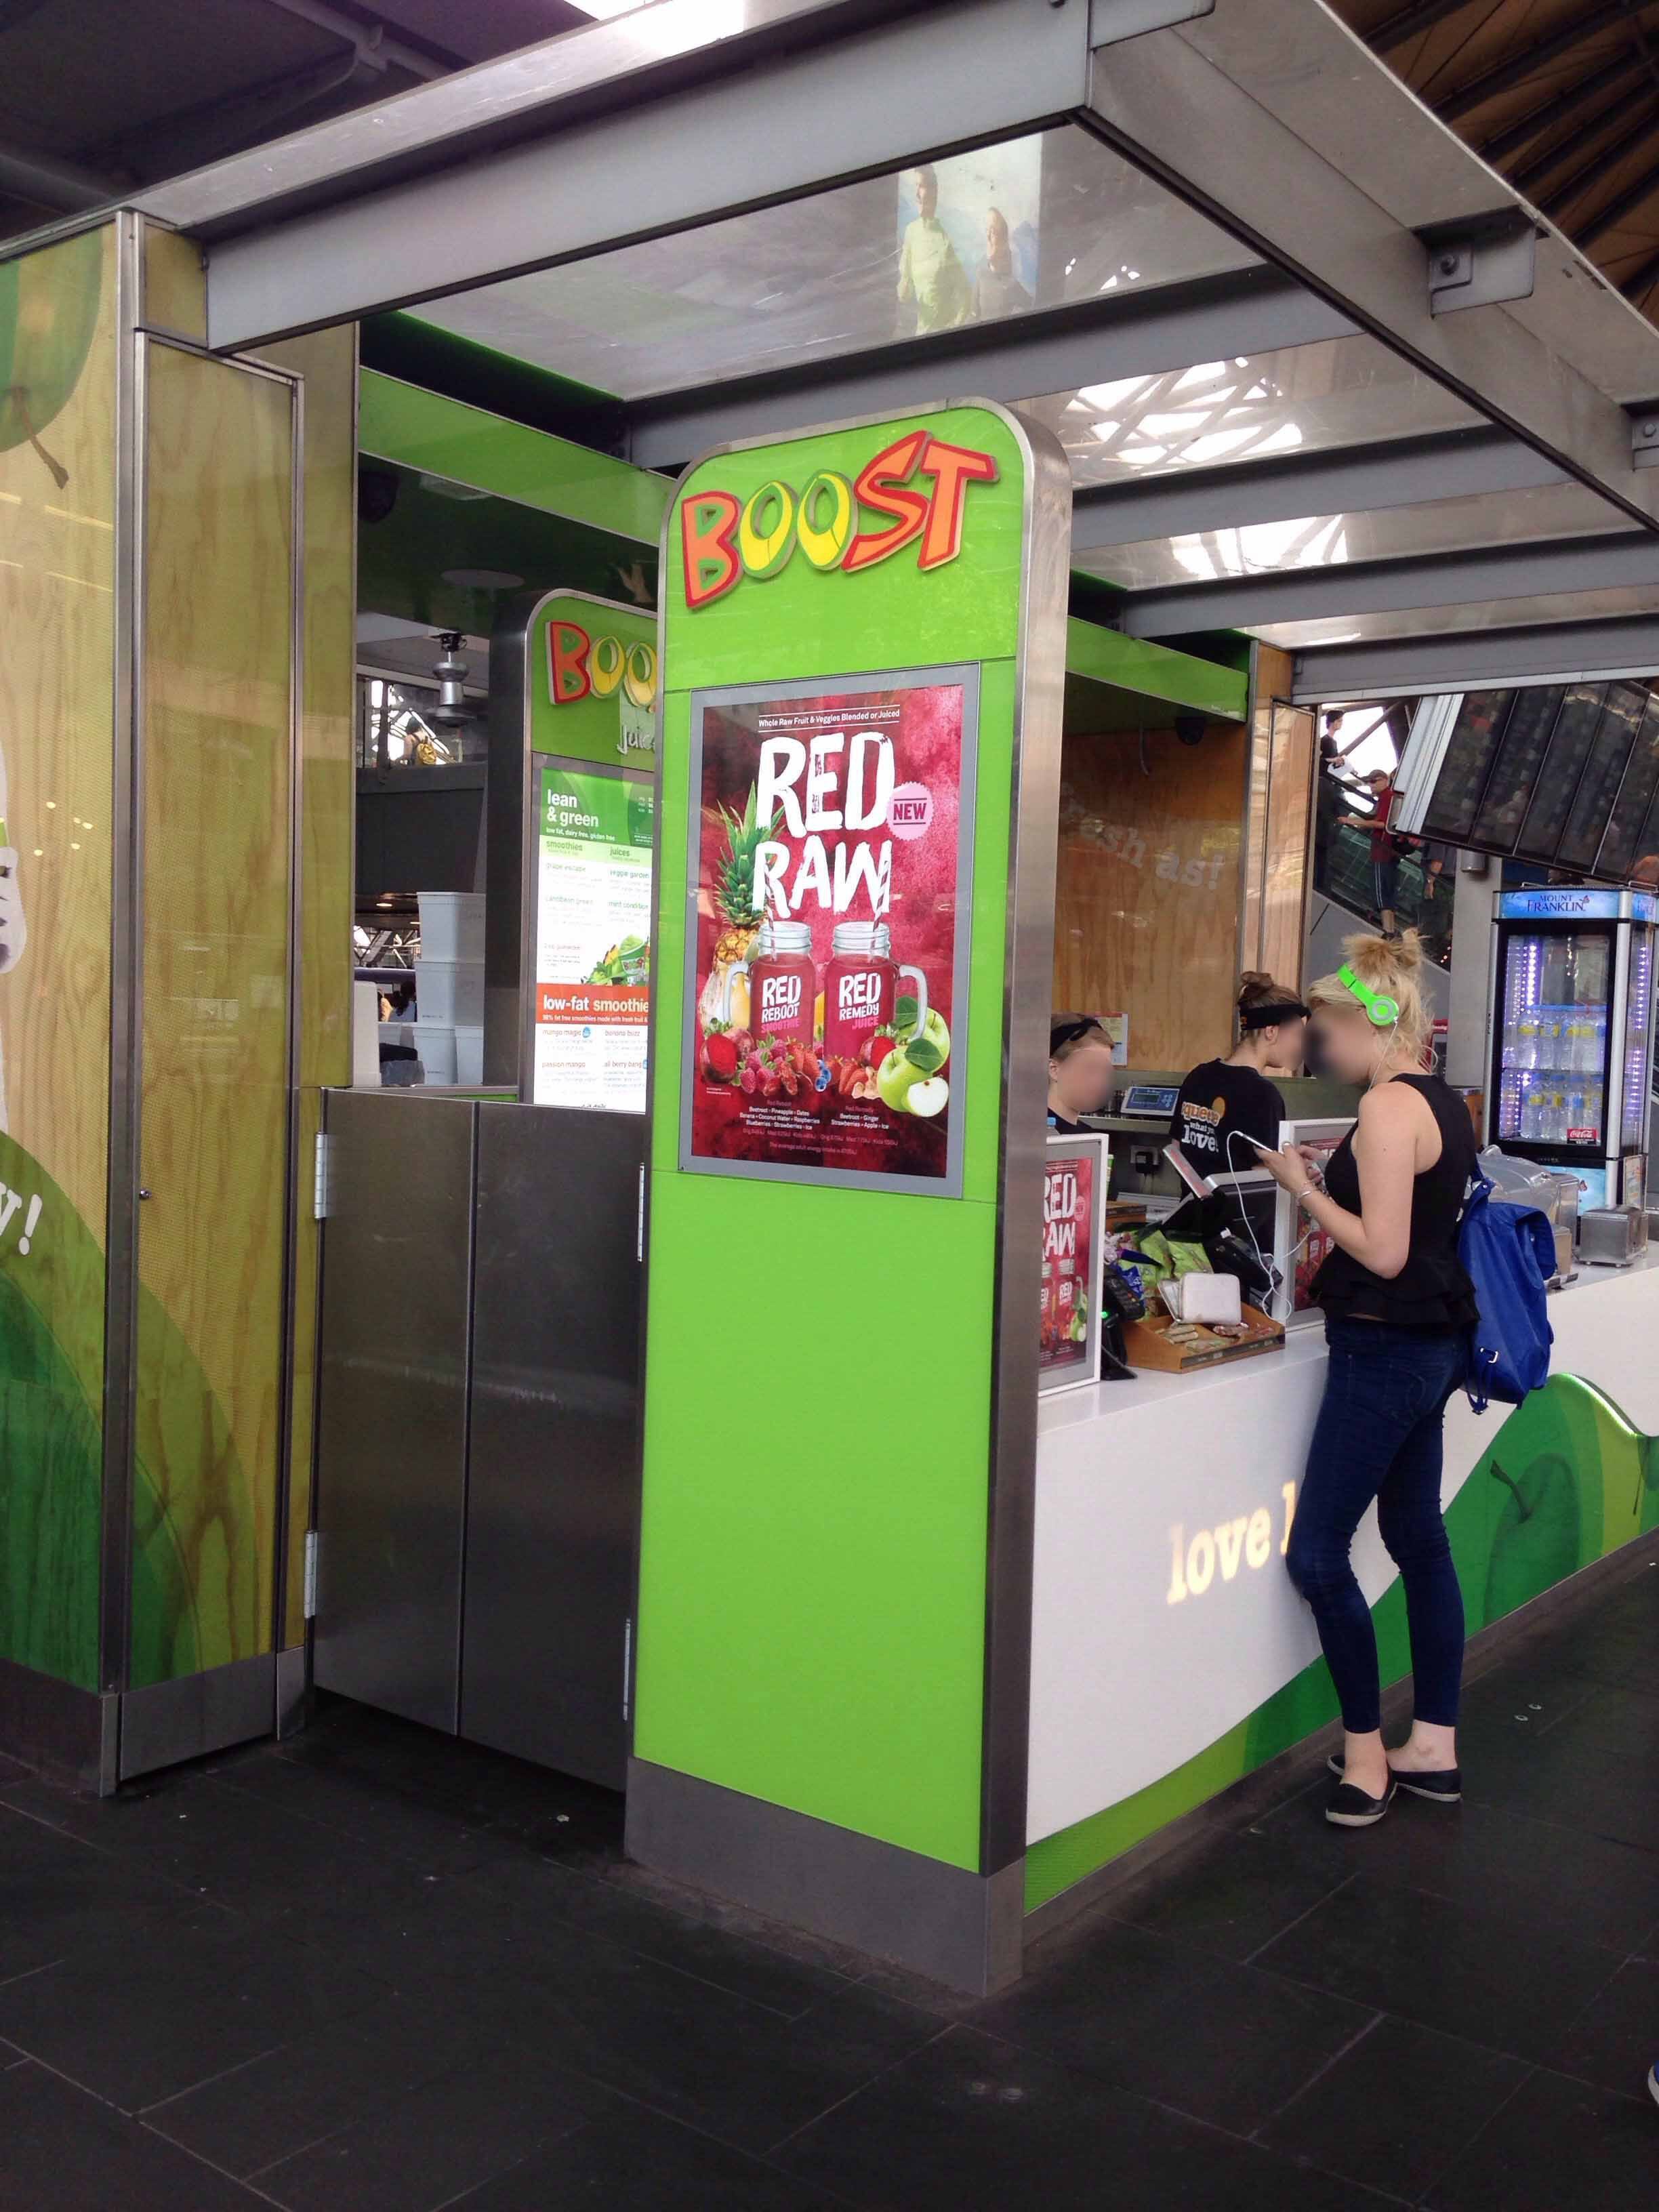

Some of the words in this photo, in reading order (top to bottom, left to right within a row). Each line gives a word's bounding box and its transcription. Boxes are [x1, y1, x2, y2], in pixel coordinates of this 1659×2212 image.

[681, 430, 999, 610] BOOST
[545, 621, 657, 707] BOO
[758, 719, 778, 727] Whole
[816, 715, 840, 724] Veggies
[841, 712, 869, 721] Blended
[878, 710, 900, 718] Juiced
[616, 724, 655, 754] Juic
[756, 731, 895, 838] RED
[547, 788, 577, 808] lean
[547, 806, 557, 822] &
[560, 811, 599, 827] green
[893, 802, 927, 821] NEW
[546, 840, 583, 852] smoothies
[609, 846, 630, 857] juices
[752, 835, 893, 918] RAW
[1527, 899, 1584, 912] FRANKLIN
[762, 975, 801, 1008] RED
[838, 972, 881, 1008] RED
[543, 993, 590, 1012] low-fat
[592, 997, 649, 1013] smoothie
[761, 1002, 800, 1023] REBOOT
[839, 1002, 880, 1022] REMEDY
[760, 1017, 801, 1033] SMOOTHIE
[851, 1016, 879, 1030] JUICE
[1189, 1122, 1207, 1132] what
[1043, 1221, 1076, 1261] AW
[1166, 1507, 1272, 1605] love
